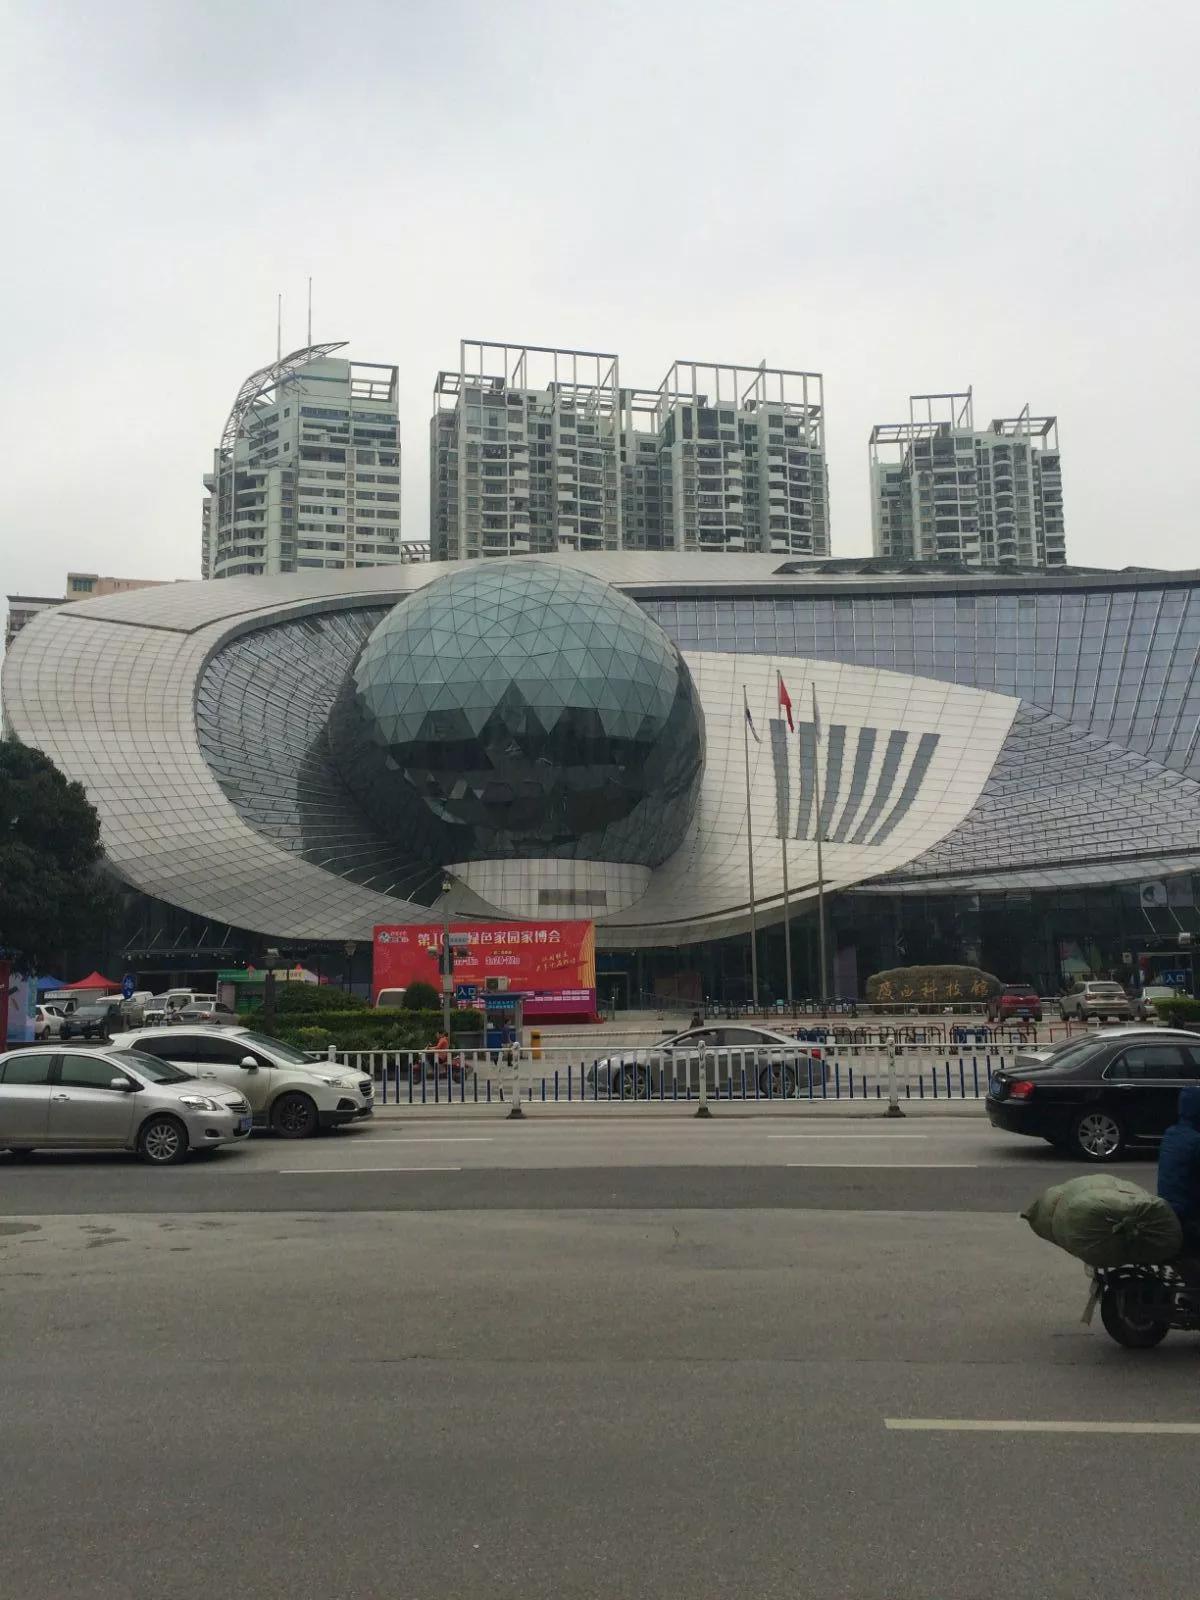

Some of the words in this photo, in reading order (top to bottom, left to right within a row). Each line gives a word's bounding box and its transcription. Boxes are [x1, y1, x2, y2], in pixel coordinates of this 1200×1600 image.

[417, 930, 561, 946] 第1绿色家园家博会
[1166, 973, 1184, 983] 入口
[458, 987, 476, 998] 入口
